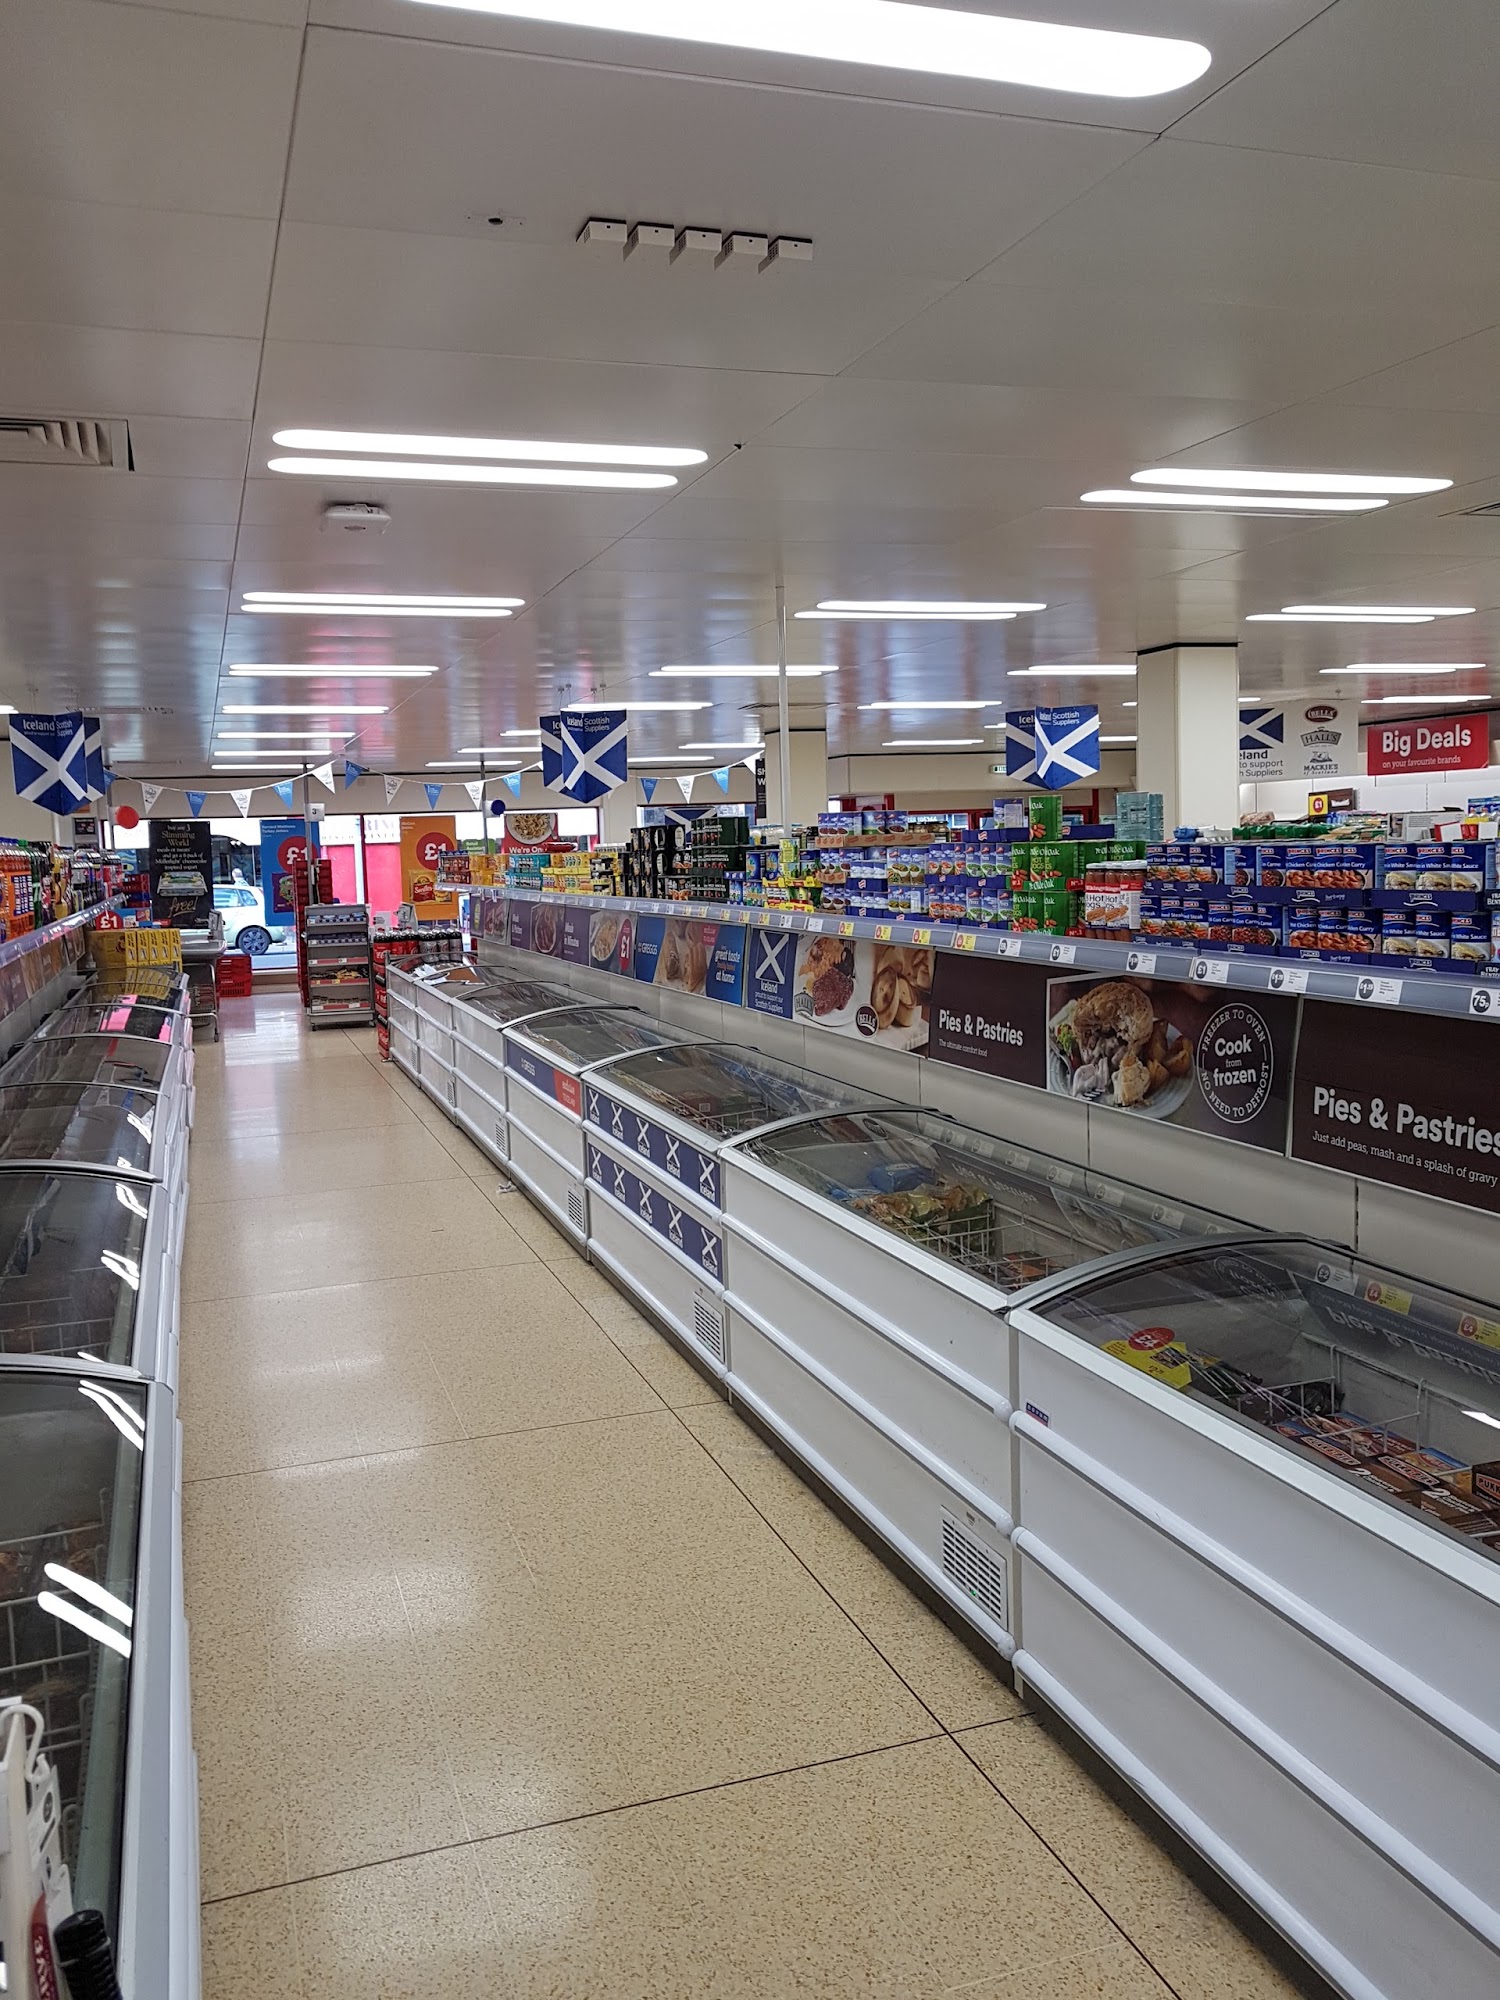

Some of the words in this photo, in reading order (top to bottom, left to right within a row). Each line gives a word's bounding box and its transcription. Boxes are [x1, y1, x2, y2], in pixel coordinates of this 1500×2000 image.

[584, 716, 610, 725] Scottish
[1019, 715, 1036, 724] Icel
[1052, 711, 1079, 720] Scottish
[23, 719, 55, 731] Iceland
[584, 725, 610, 733] Suppliers
[1382, 730, 1411, 757] Big
[1417, 724, 1472, 750] Deals
[1247, 760, 1284, 770] support
[1392, 759, 1408, 769] your
[1408, 757, 1436, 766] favourite
[1437, 755, 1461, 764] brands
[1246, 769, 1283, 777] Suppliers
[161, 831, 195, 840] Slimming
[168, 897, 198, 918] free!
[100, 915, 118, 929] £1
[620, 935, 630, 959] £1
[715, 950, 729, 962] great
[729, 951, 741, 963] taste
[716, 970, 722, 981] at
[722, 971, 735, 983] home
[1197, 965, 1206, 975] £1
[761, 980, 778, 993] Iceland
[1473, 994, 1490, 1009] 75p
[939, 1009, 961, 1032] Pies
[964, 1014, 973, 1035] &
[976, 1016, 1023, 1046] Pastries
[1201, 1010, 1231, 1052] FREEZER
[1232, 1009, 1245, 1020] TO
[1245, 1014, 1267, 1043] OVEN
[962, 1045, 978, 1055] comfort
[978, 1048, 988, 1057] food
[1214, 1033, 1252, 1056] Cook
[1225, 1059, 1242, 1068] from
[1213, 1068, 1257, 1087] frozen
[1201, 1071, 1211, 1091] NO
[1209, 1091, 1231, 1115] NEED
[1232, 1107, 1245, 1117] TO
[1246, 1062, 1270, 1113] DEFROST
[1313, 1086, 1362, 1124] Pies
[1368, 1097, 1389, 1131] &
[1312, 1130, 1330, 1144] Just
[1330, 1136, 1346, 1148] add
[1347, 1141, 1368, 1155] peas,
[1370, 1146, 1395, 1161] mash
[1397, 1153, 1414, 1165] and
[1415, 1157, 1422, 1167] a
[1423, 1159, 1454, 1175] splash
[1456, 1167, 1467, 1178] of
[1468, 1170, 1499, 1188] gravy
[1422, 1487, 1451, 1500] 2
